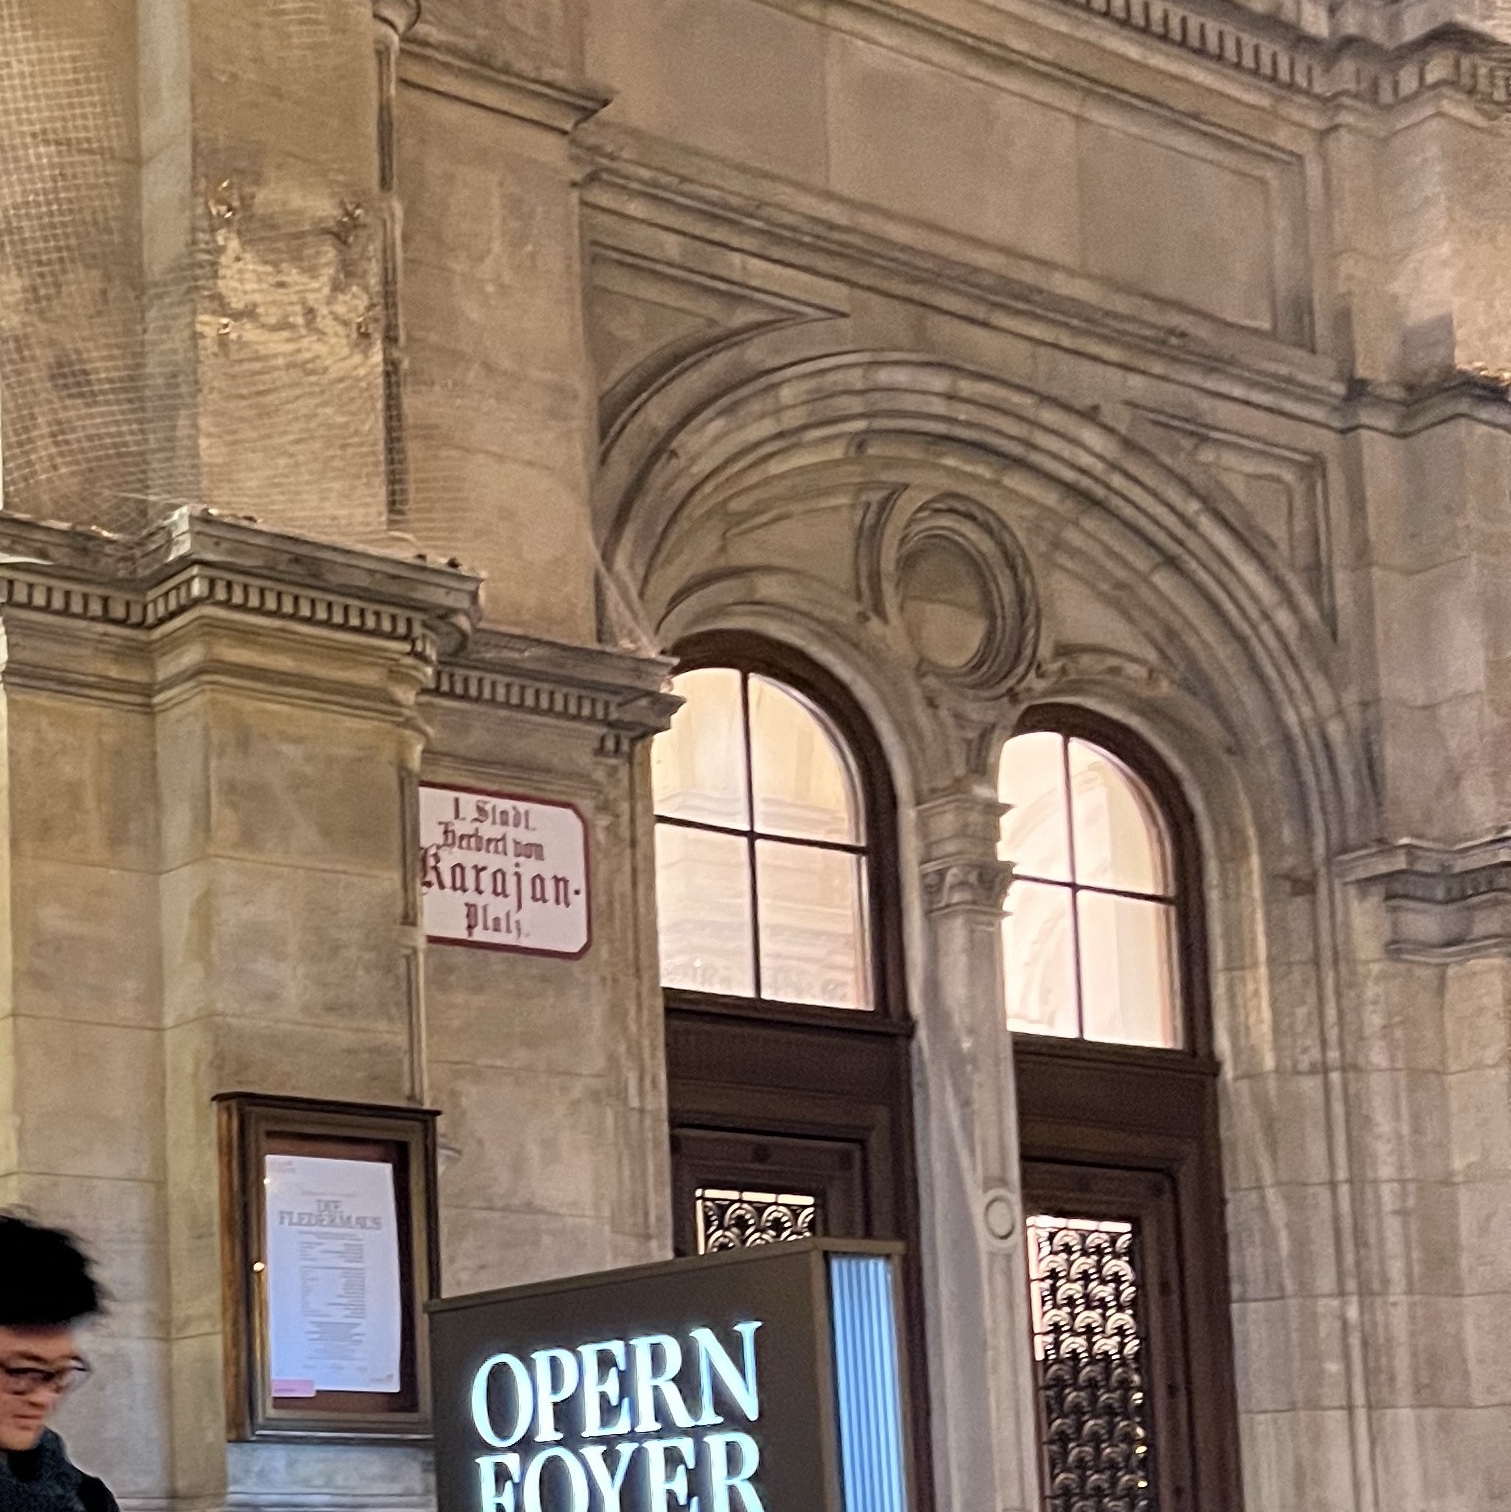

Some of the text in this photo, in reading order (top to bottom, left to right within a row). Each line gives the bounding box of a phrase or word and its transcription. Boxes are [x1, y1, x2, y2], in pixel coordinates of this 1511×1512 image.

[437, 821, 545, 862] Herbert von
[278, 1210, 383, 1231] FLEDERMAUS
[472, 1320, 763, 1448] OPERN
